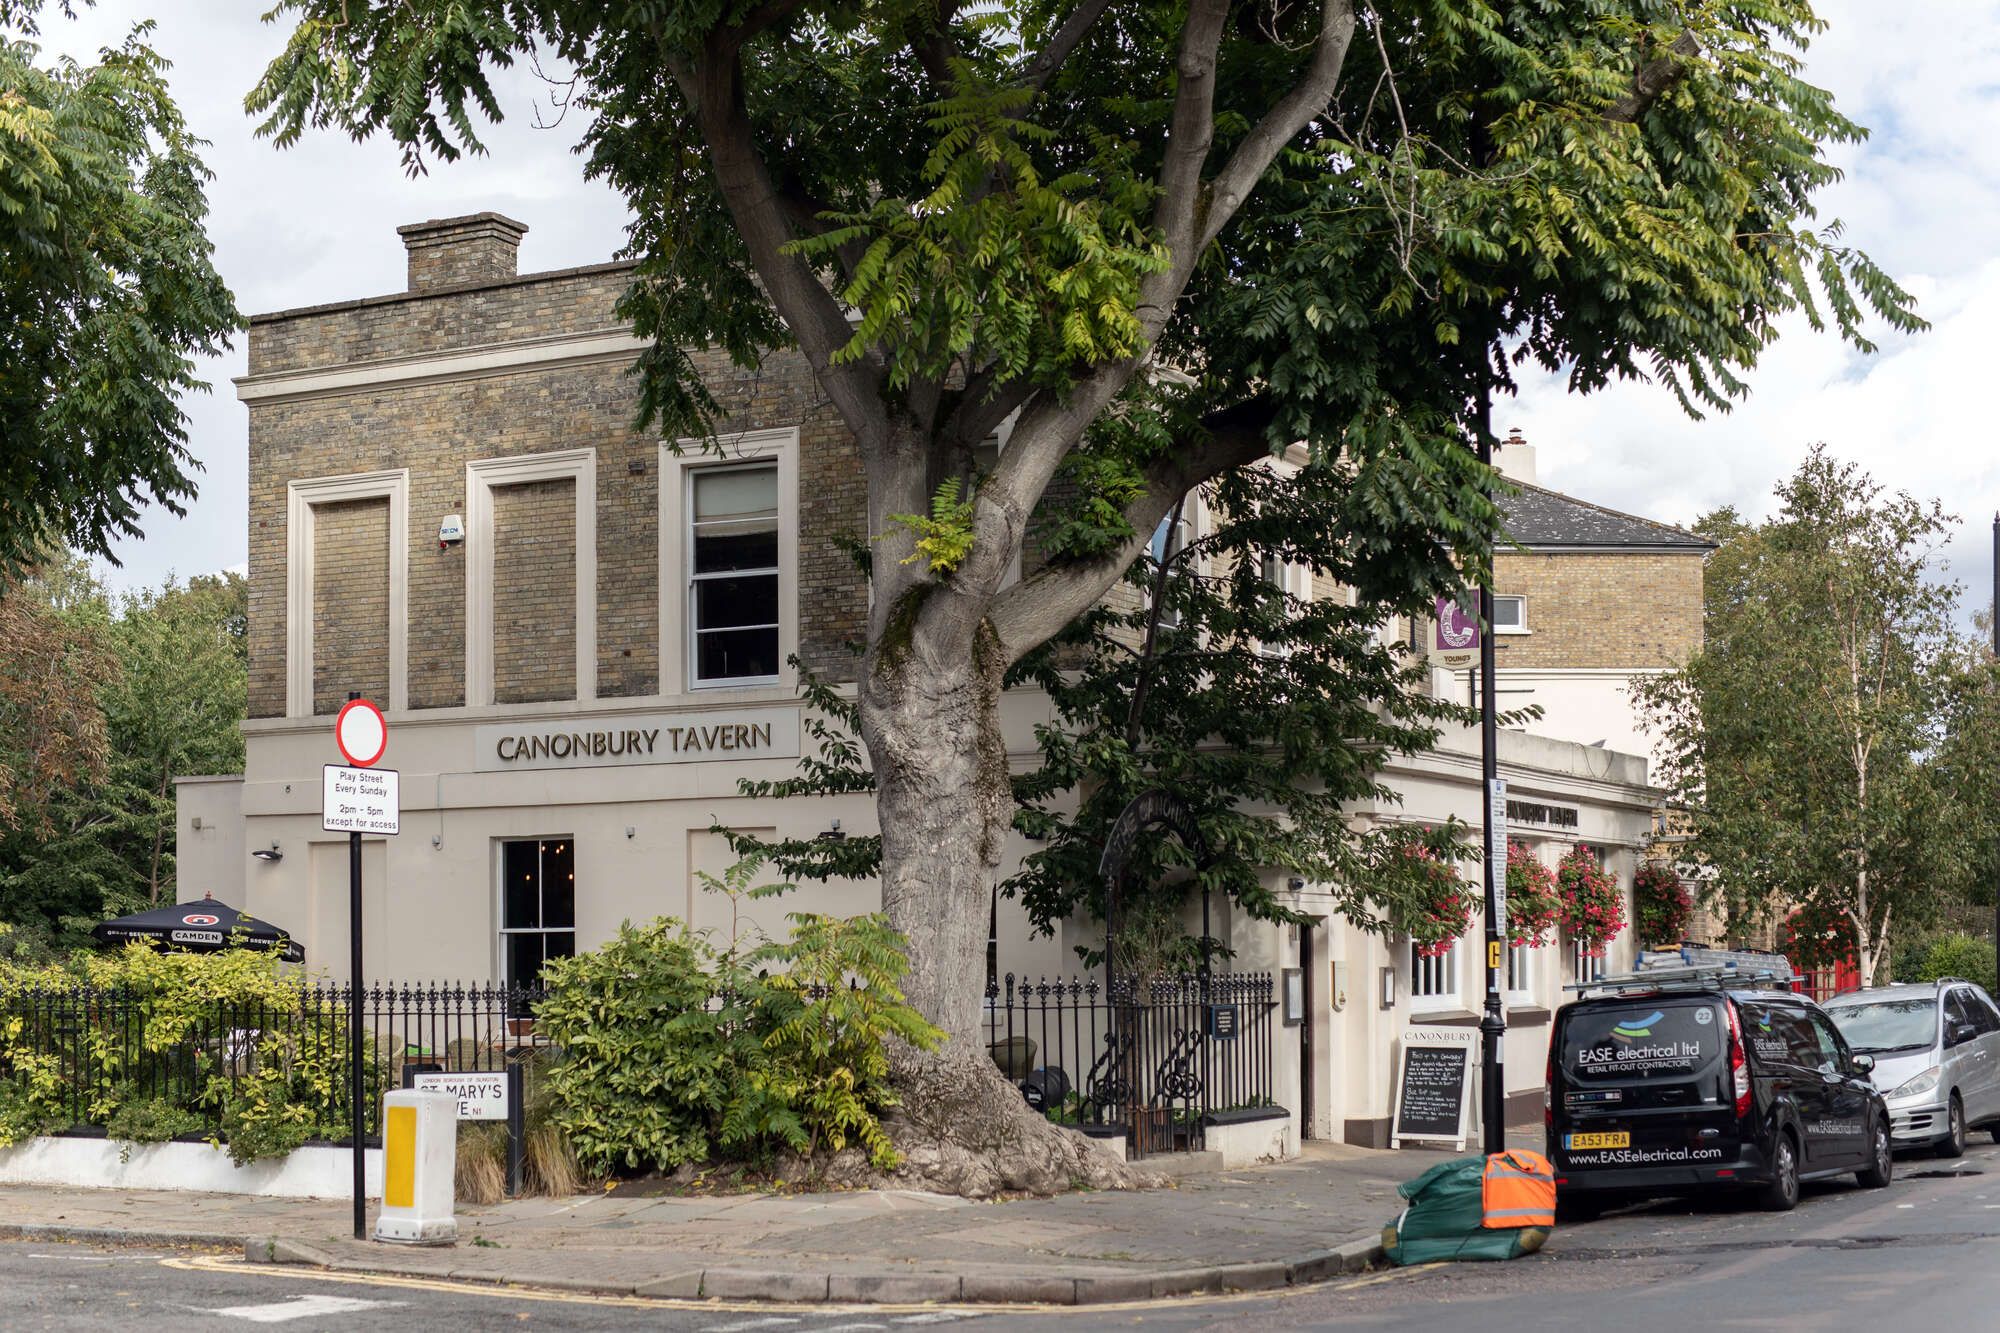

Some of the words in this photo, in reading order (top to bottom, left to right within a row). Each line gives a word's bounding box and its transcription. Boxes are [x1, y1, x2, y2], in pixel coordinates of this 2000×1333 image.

[496, 729, 660, 762] CANONBURY
[667, 722, 771, 752] TAVERN
[340, 771, 356, 782] Play
[359, 773, 384, 784] Street
[335, 783, 356, 795] Every
[359, 785, 387, 797] Sunday
[339, 804, 357, 814] 2pm
[367, 806, 384, 816] 5pm
[326, 818, 353, 827] except
[356, 818, 368, 827] for
[369, 822, 397, 830] access
[175, 932, 219, 941] CAMDEN
[1404, 1032, 1472, 1041] CANONBURY
[1578, 1047, 1613, 1064] EASE
[1616, 1041, 1677, 1060] electrical
[1682, 1040, 1700, 1056] ltd
[1587, 1064, 1607, 1074] RETAIL
[1608, 1063, 1635, 1072] FIT-OUT
[1637, 1058, 1691, 1070] CONTRACTORS
[446, 1085, 502, 1099] MARY'S
[1573, 1134, 1602, 1147] EA53
[1604, 1132, 1627, 1145] FRA
[1569, 1147, 1722, 1165] www.EASEelectrical.com
